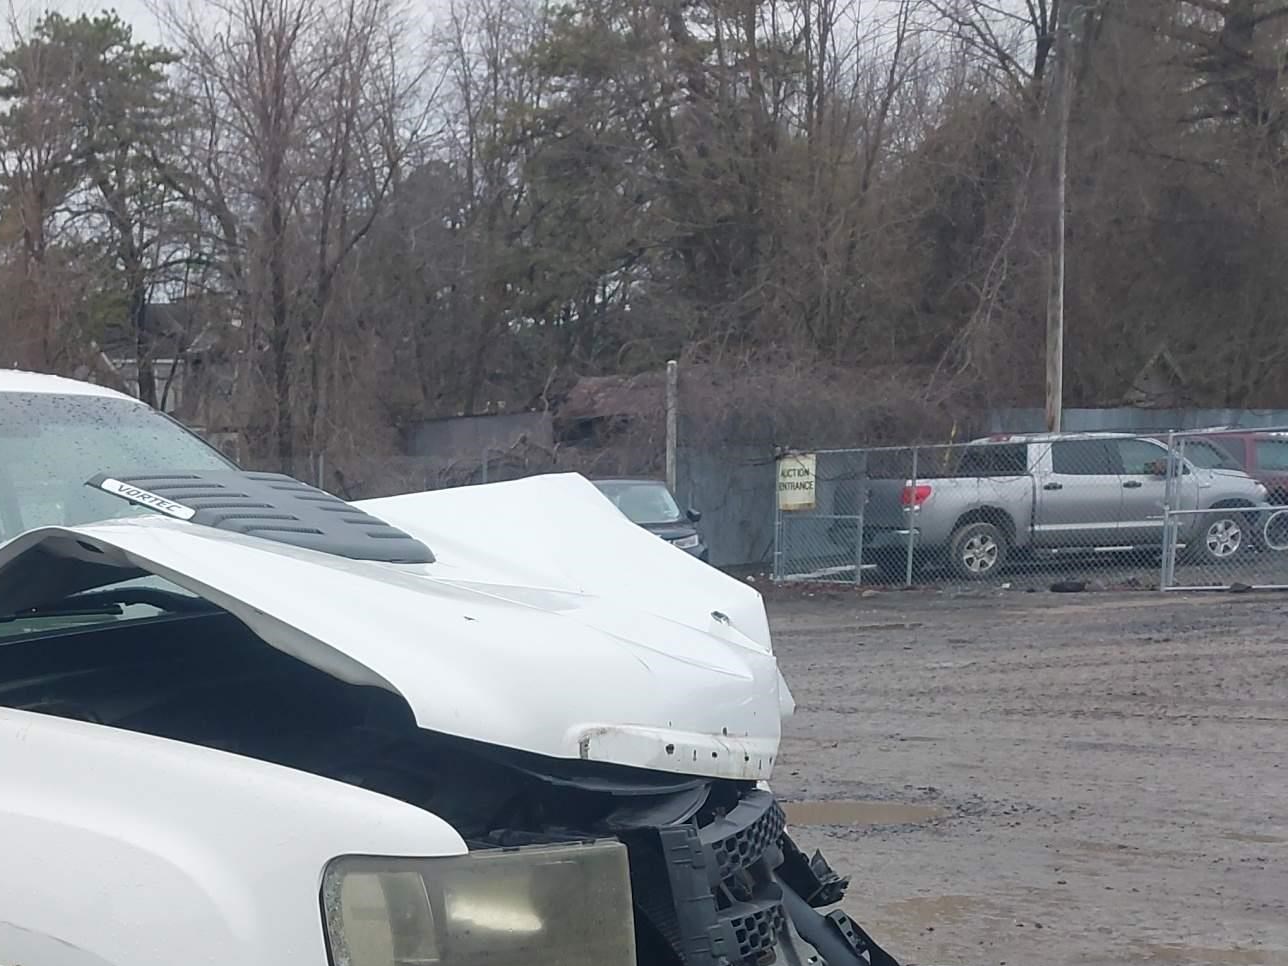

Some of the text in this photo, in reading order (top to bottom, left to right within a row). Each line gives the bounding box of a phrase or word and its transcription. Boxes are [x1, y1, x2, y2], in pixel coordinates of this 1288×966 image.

[781, 467, 810, 478] AUCTION
[778, 480, 814, 491] ENTRANCE
[117, 484, 181, 512] VORTEC
